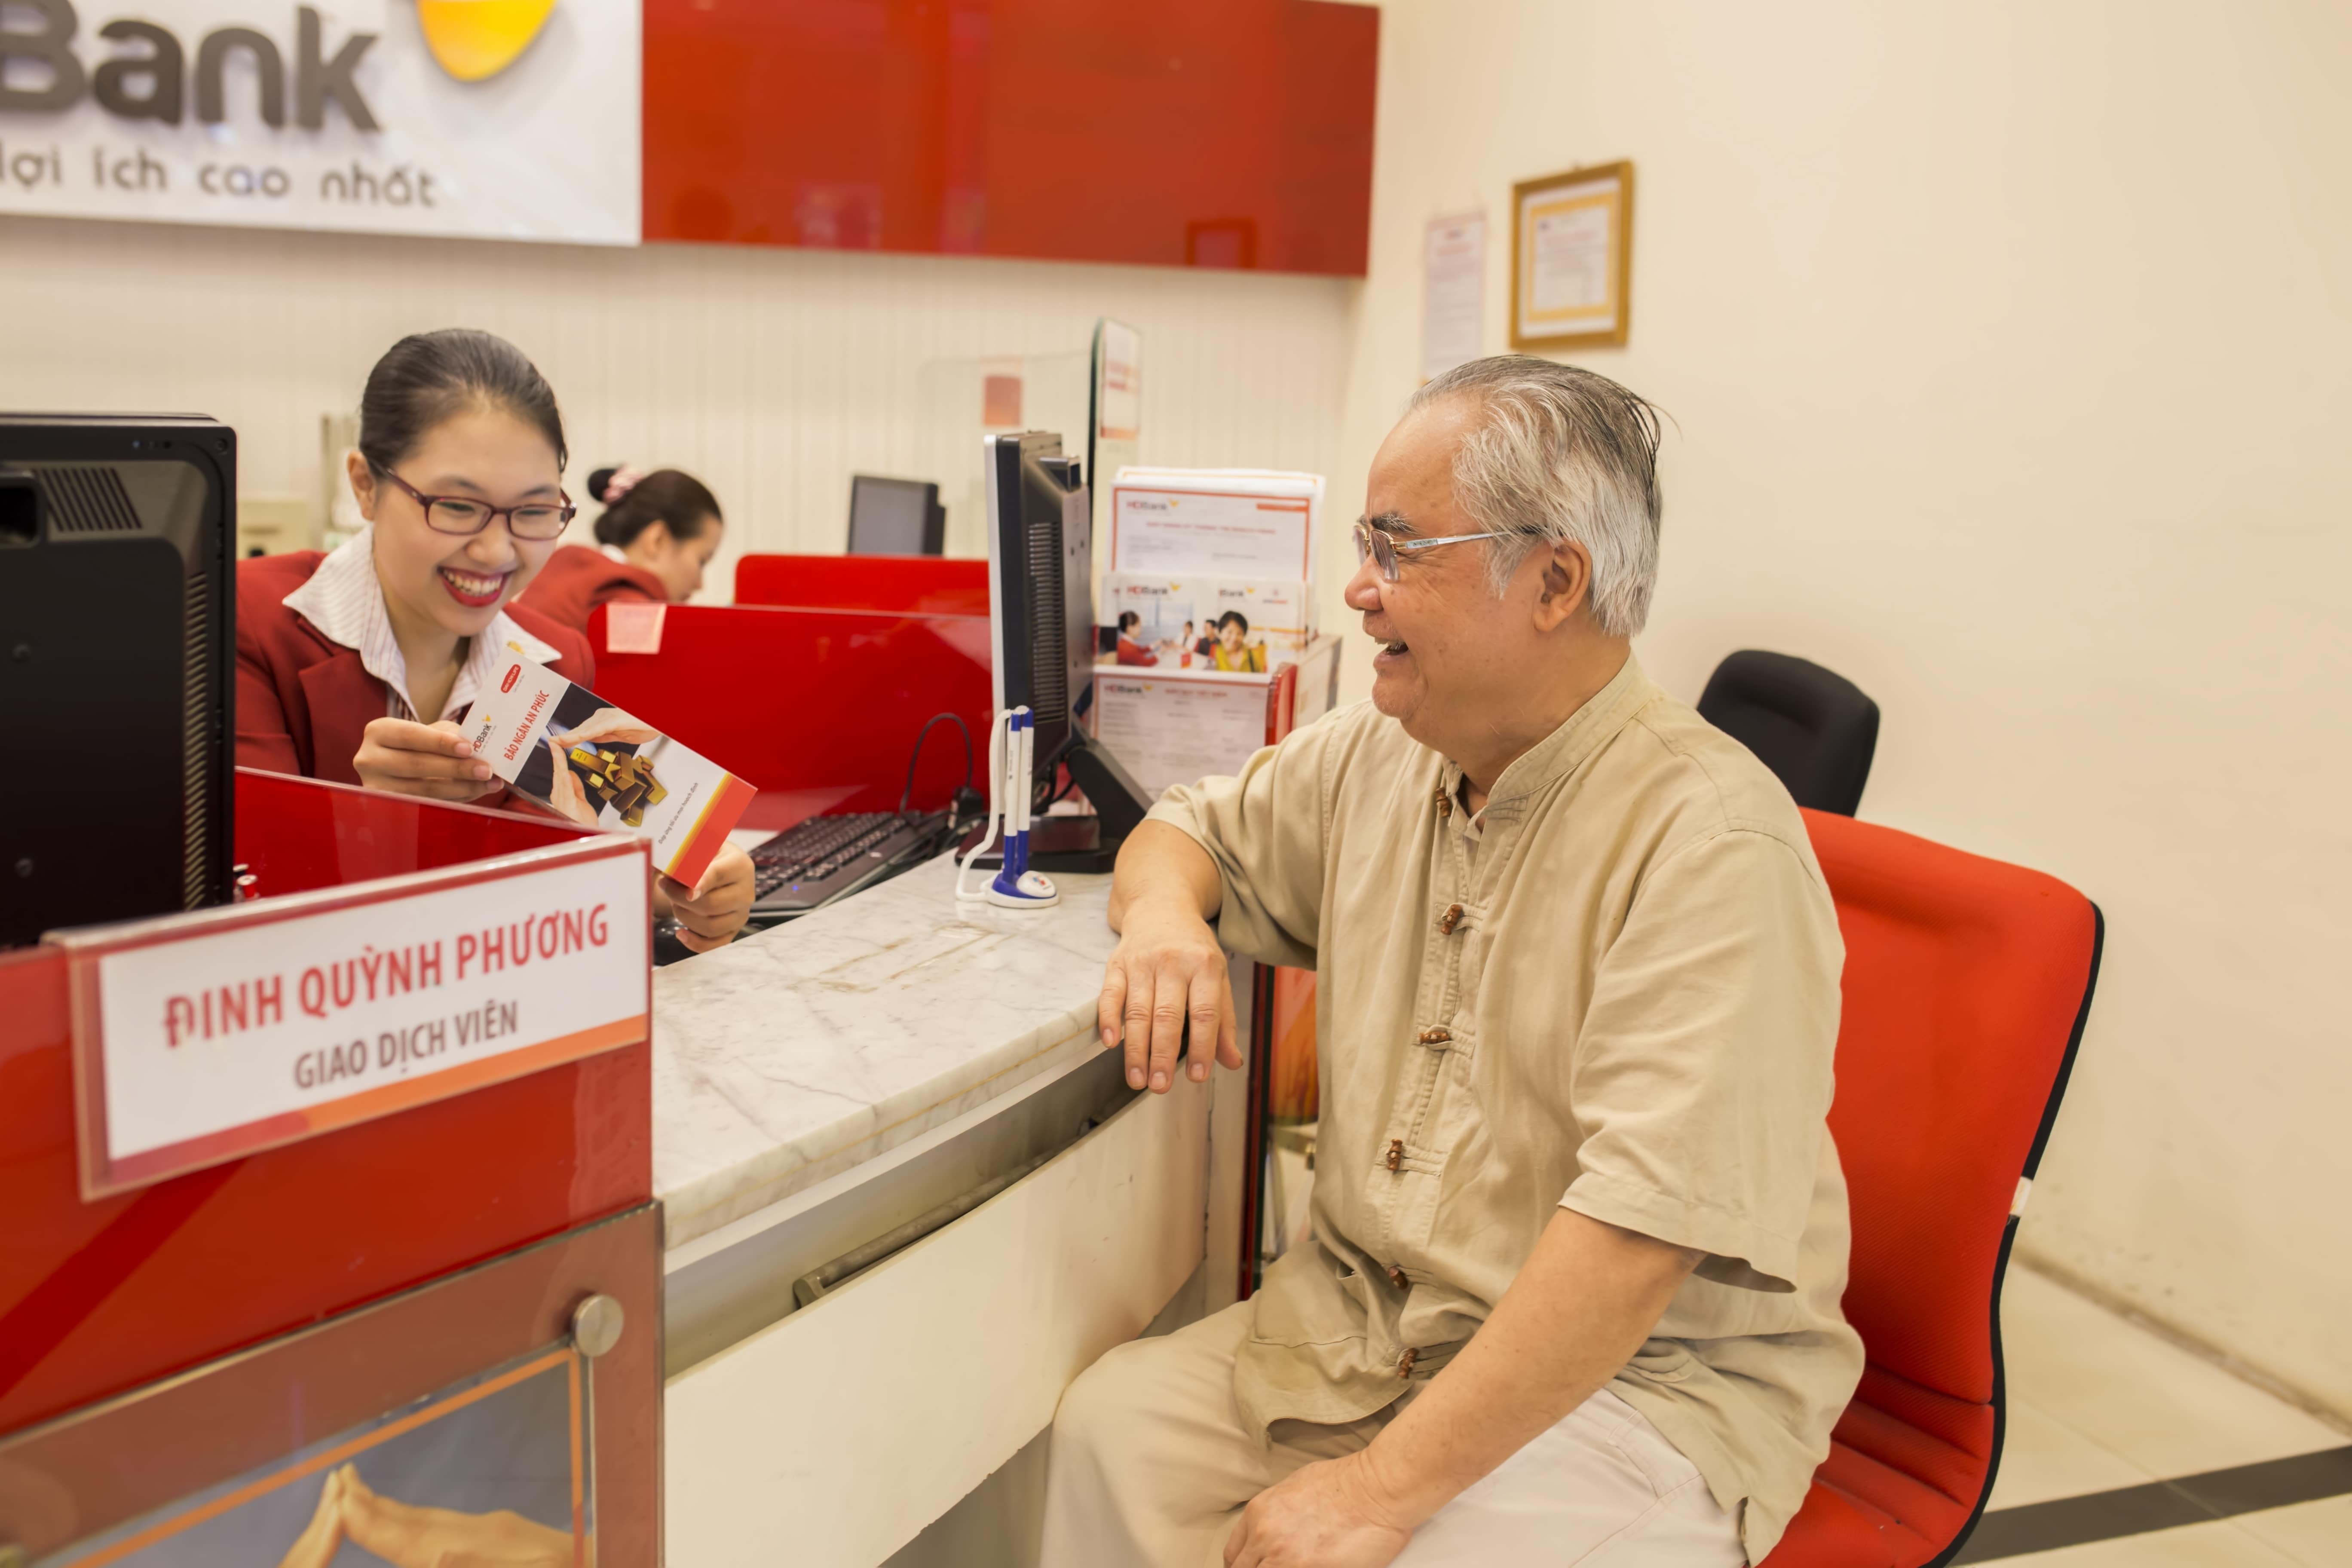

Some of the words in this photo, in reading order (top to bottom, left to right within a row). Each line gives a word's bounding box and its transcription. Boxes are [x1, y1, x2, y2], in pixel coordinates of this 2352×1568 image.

[198, 162, 292, 199] cao
[320, 162, 438, 208] nhất
[530, 689, 549, 713] PHÚC
[524, 710, 537, 725] AN
[473, 723, 492, 752] HDBank
[512, 723, 531, 745] NGÂN
[503, 743, 519, 761] BẢO
[162, 973, 285, 1049] ĐINH
[297, 940, 442, 1019] QUỲNH
[456, 903, 609, 981] PHƯƠNG
[294, 1039, 368, 1089] GIAO
[377, 1017, 446, 1073] DỊCH
[454, 999, 518, 1048] VIÊN
